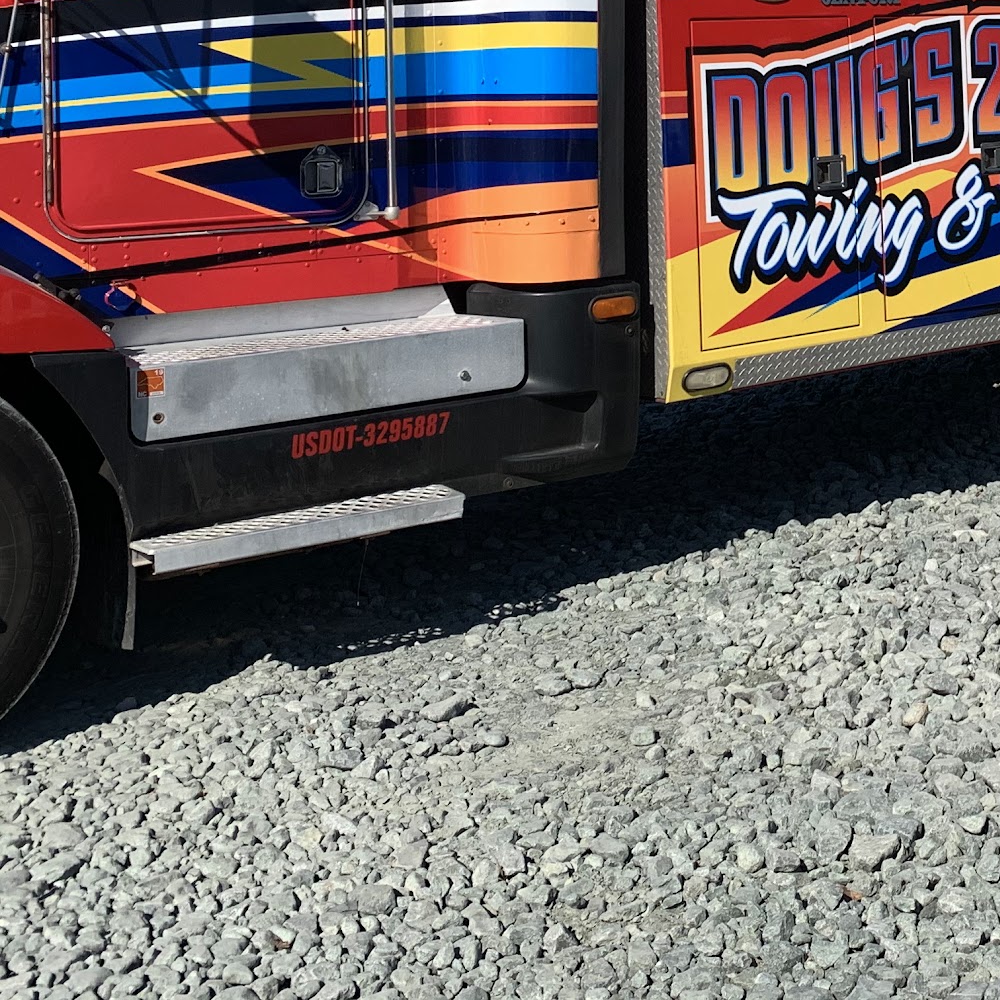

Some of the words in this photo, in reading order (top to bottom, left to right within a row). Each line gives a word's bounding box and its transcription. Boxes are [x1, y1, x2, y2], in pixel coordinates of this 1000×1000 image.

[711, 27, 955, 193] DOUG'S
[717, 177, 928, 284] Towing
[934, 163, 995, 250] &
[291, 411, 450, 460] USDOT-3295887
